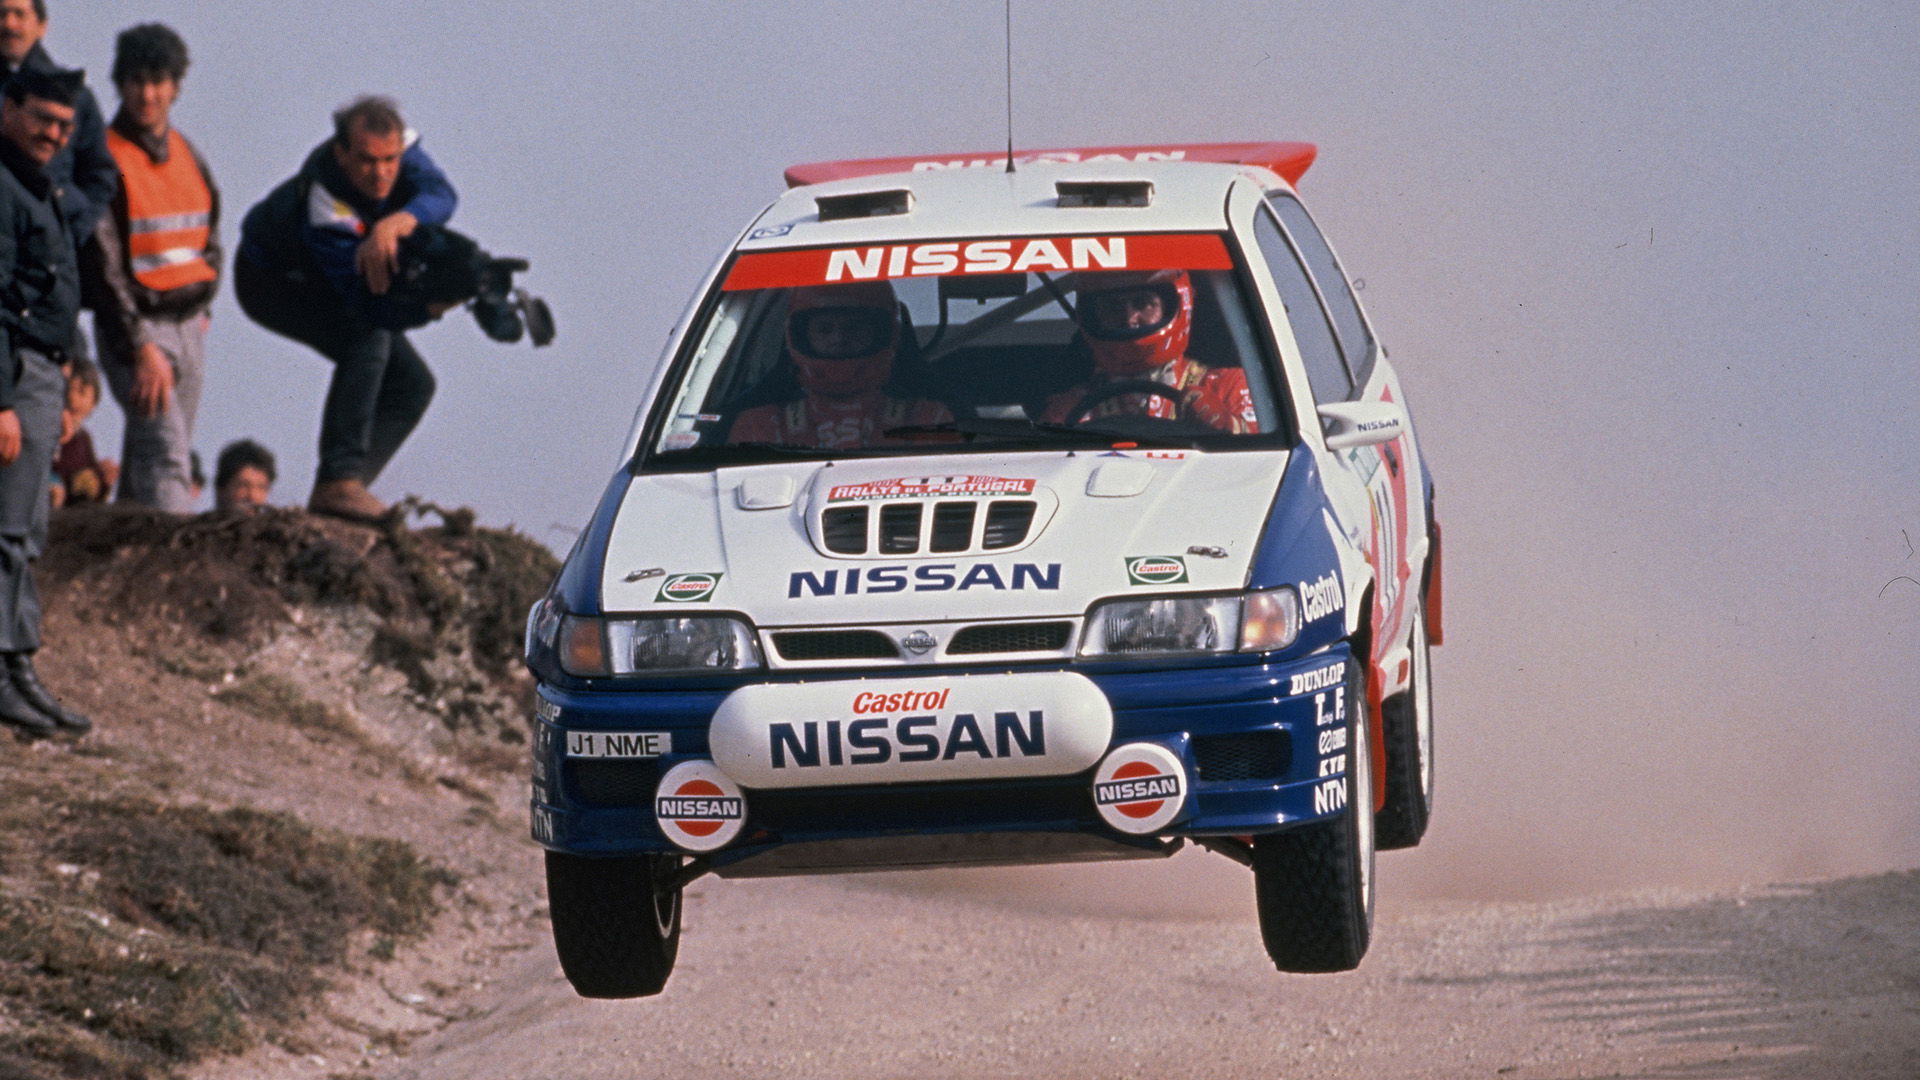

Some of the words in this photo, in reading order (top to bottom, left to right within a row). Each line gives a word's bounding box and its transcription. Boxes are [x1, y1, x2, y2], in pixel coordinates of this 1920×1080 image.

[825, 238, 1127, 282] NISSAN
[1357, 418, 1400, 433] NISSAN
[927, 480, 1028, 493] PORTUGAL
[787, 562, 1062, 599] NISSAN
[1138, 564, 1180, 573] Castrol
[671, 582, 711, 590] Castrol
[1299, 569, 1345, 623] Castrol
[1289, 661, 1346, 696] DUNLOP
[852, 687, 951, 715] Castrol
[571, 737, 593, 755] J1
[605, 735, 660, 756] NME
[768, 710, 1047, 769] NISSAN
[1099, 778, 1178, 802] NISSAN
[1314, 776, 1347, 816] NTN
[660, 799, 739, 817] NISSAN
